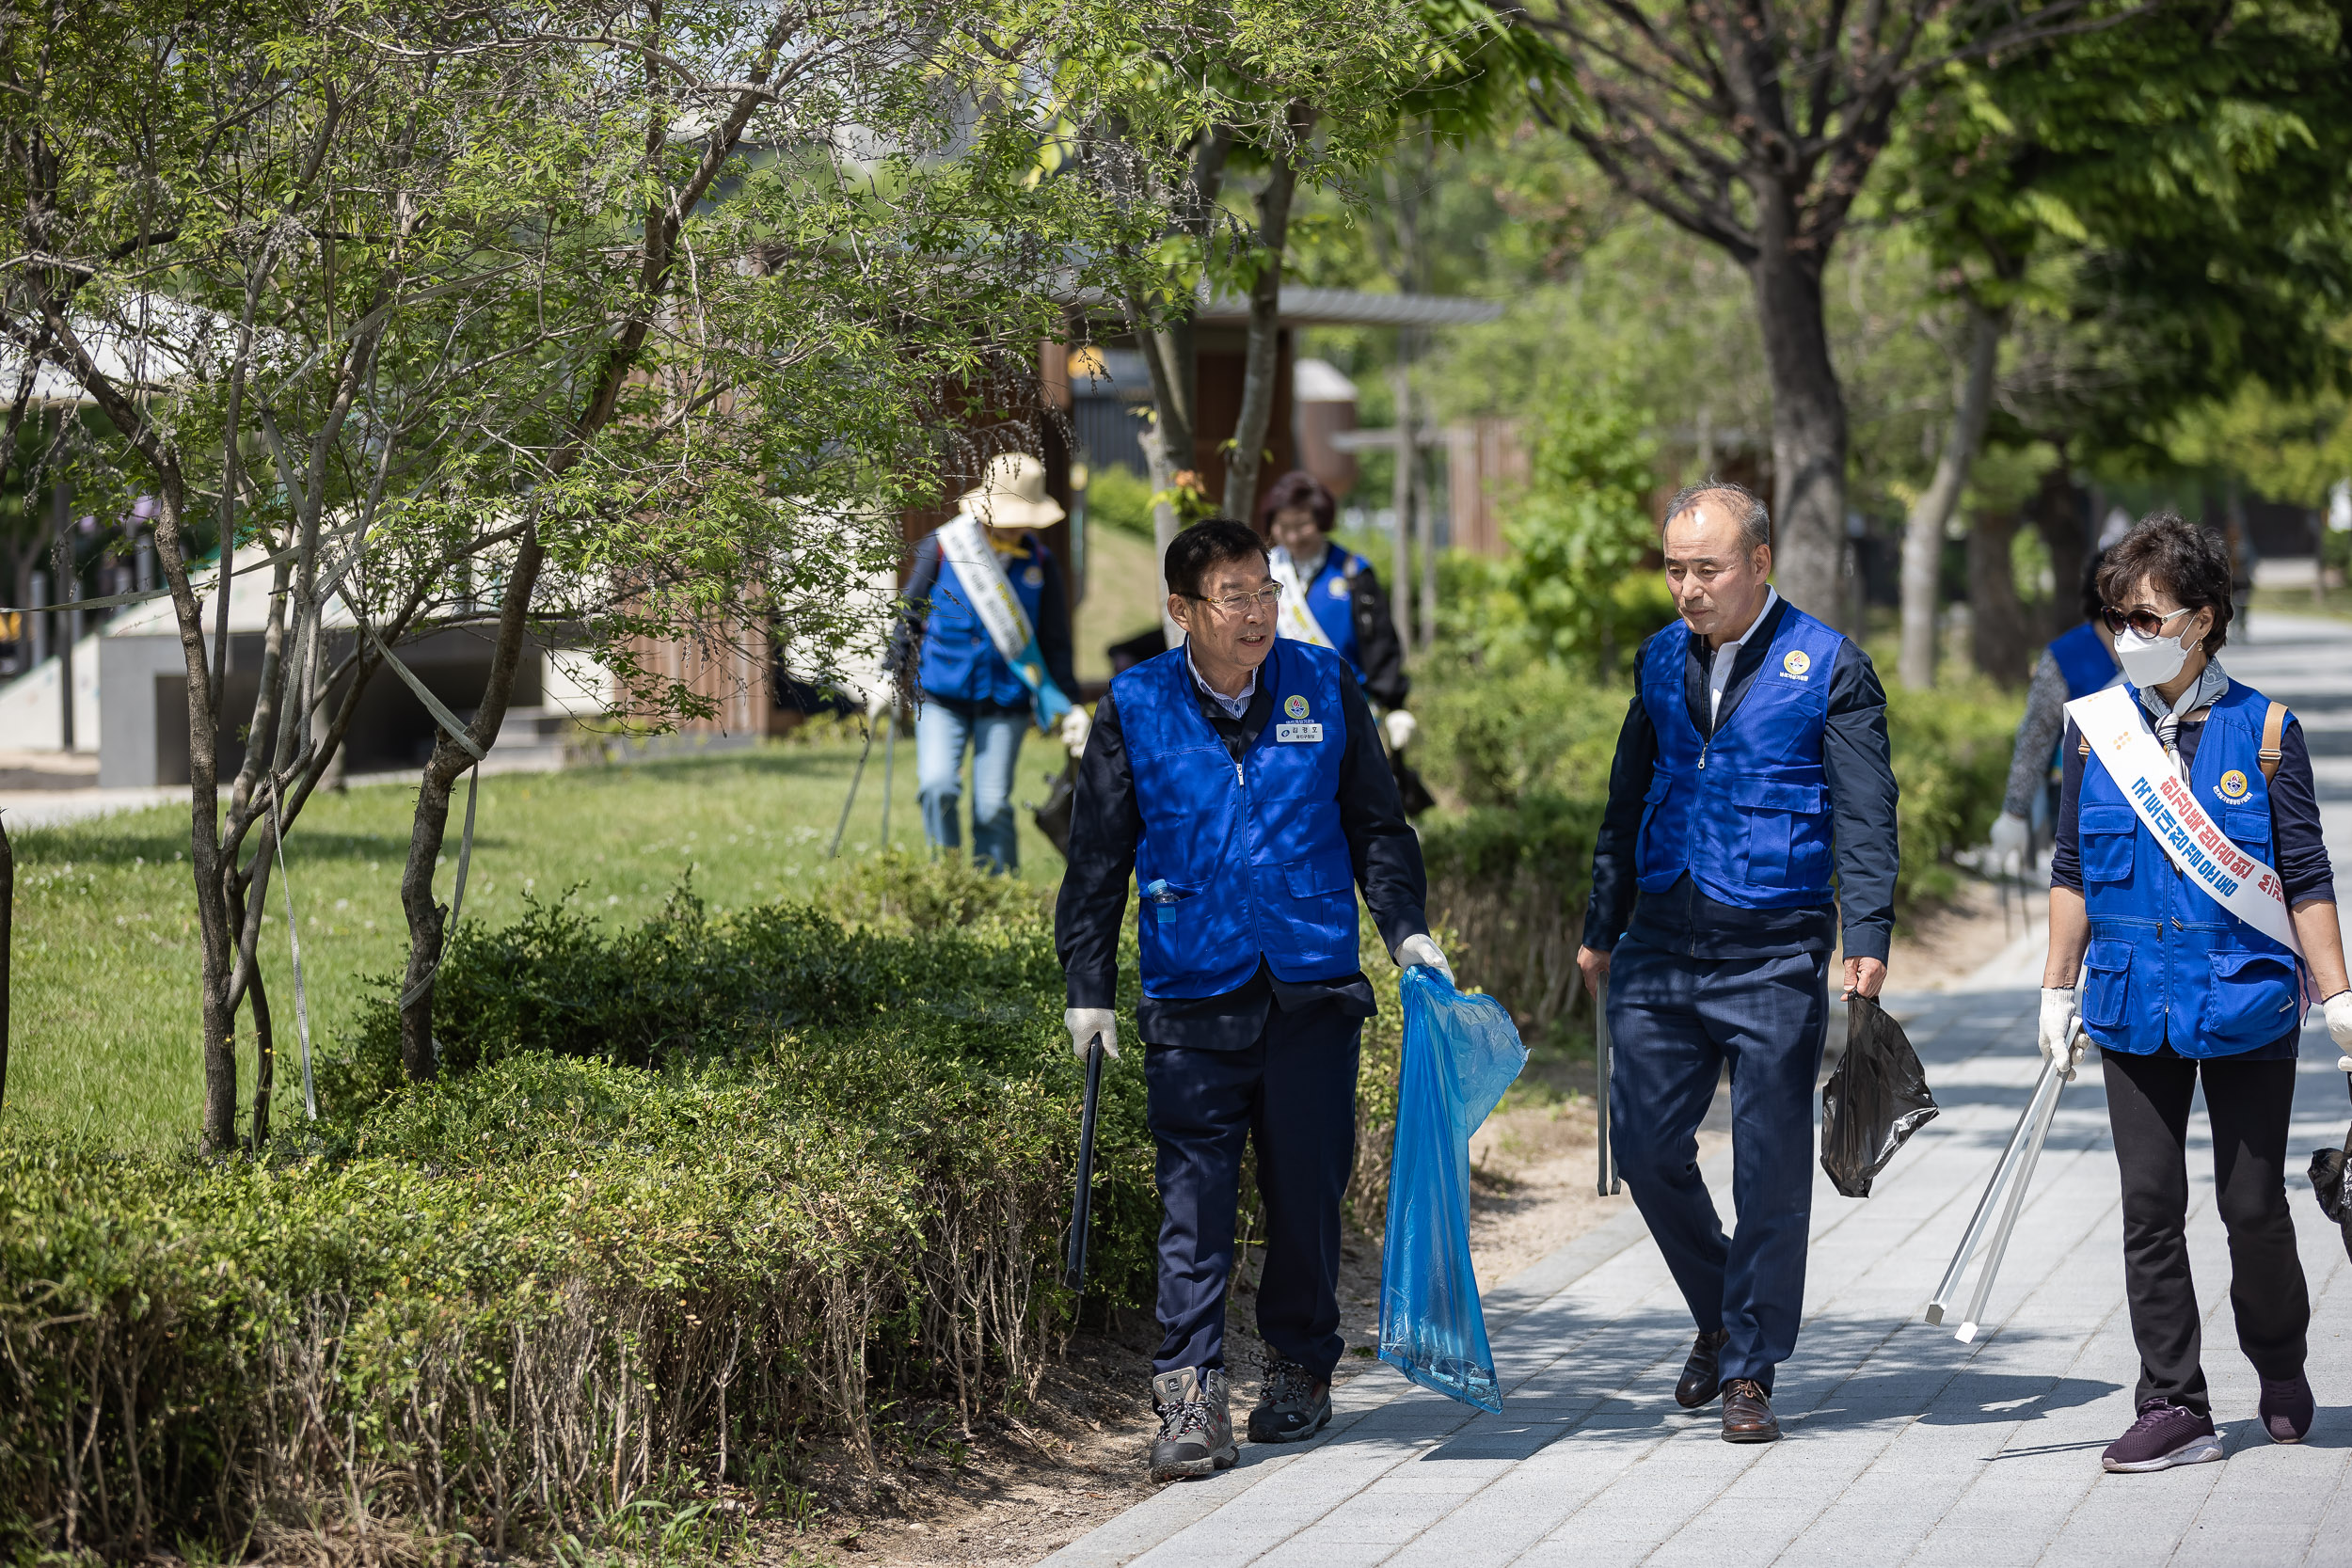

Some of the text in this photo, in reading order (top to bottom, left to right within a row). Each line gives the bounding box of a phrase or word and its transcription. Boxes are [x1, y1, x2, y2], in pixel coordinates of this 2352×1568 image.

[2131, 776, 2239, 897] 국토대청결운동
[2160, 775, 2284, 905] 한강뚝섬공원 쓰레
